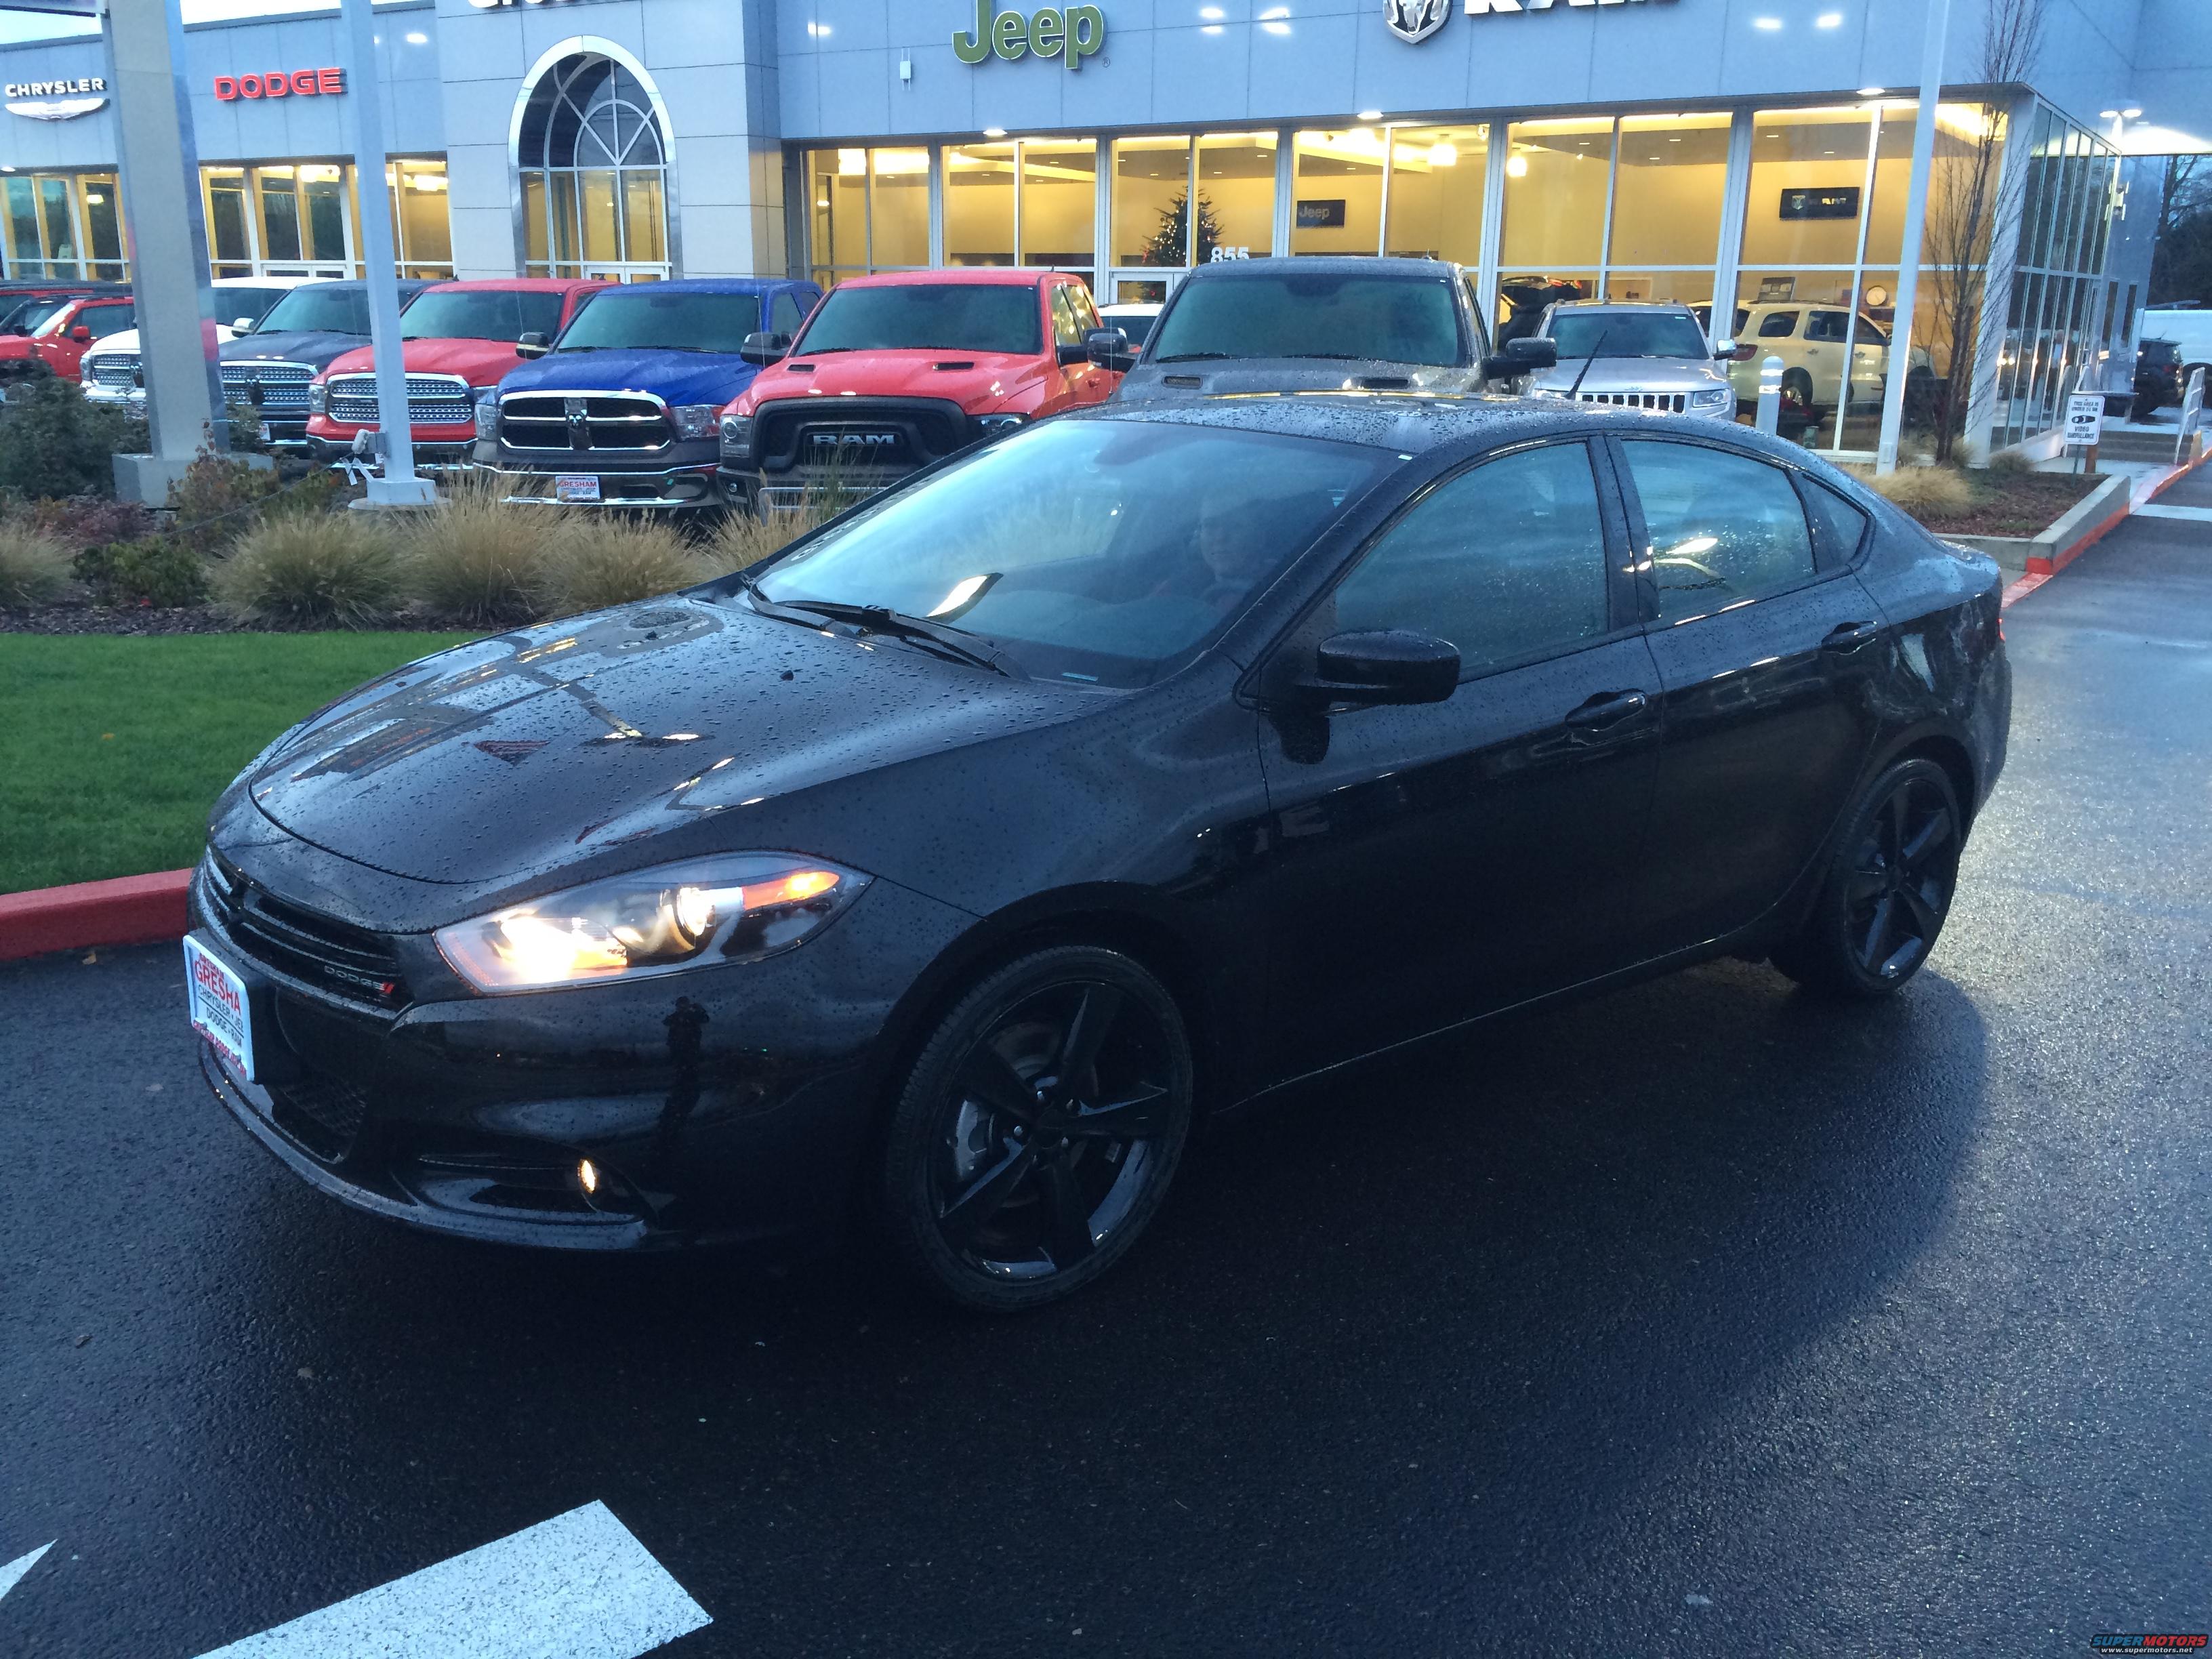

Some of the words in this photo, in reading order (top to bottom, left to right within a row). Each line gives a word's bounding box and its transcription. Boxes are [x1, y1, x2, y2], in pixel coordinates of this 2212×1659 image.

[952, 0, 1105, 69] Jeep
[5, 77, 104, 97] CHRYSLER
[214, 67, 342, 100] DODGE
[1298, 205, 1330, 220] Jeep
[1210, 247, 1250, 263] 855
[813, 434, 895, 445] RAM
[194, 960, 241, 1016] GRESHA
[324, 965, 386, 991] DODGE
[199, 984, 230, 1017] CHRYSLER
[206, 1007, 228, 1033] DODGE
